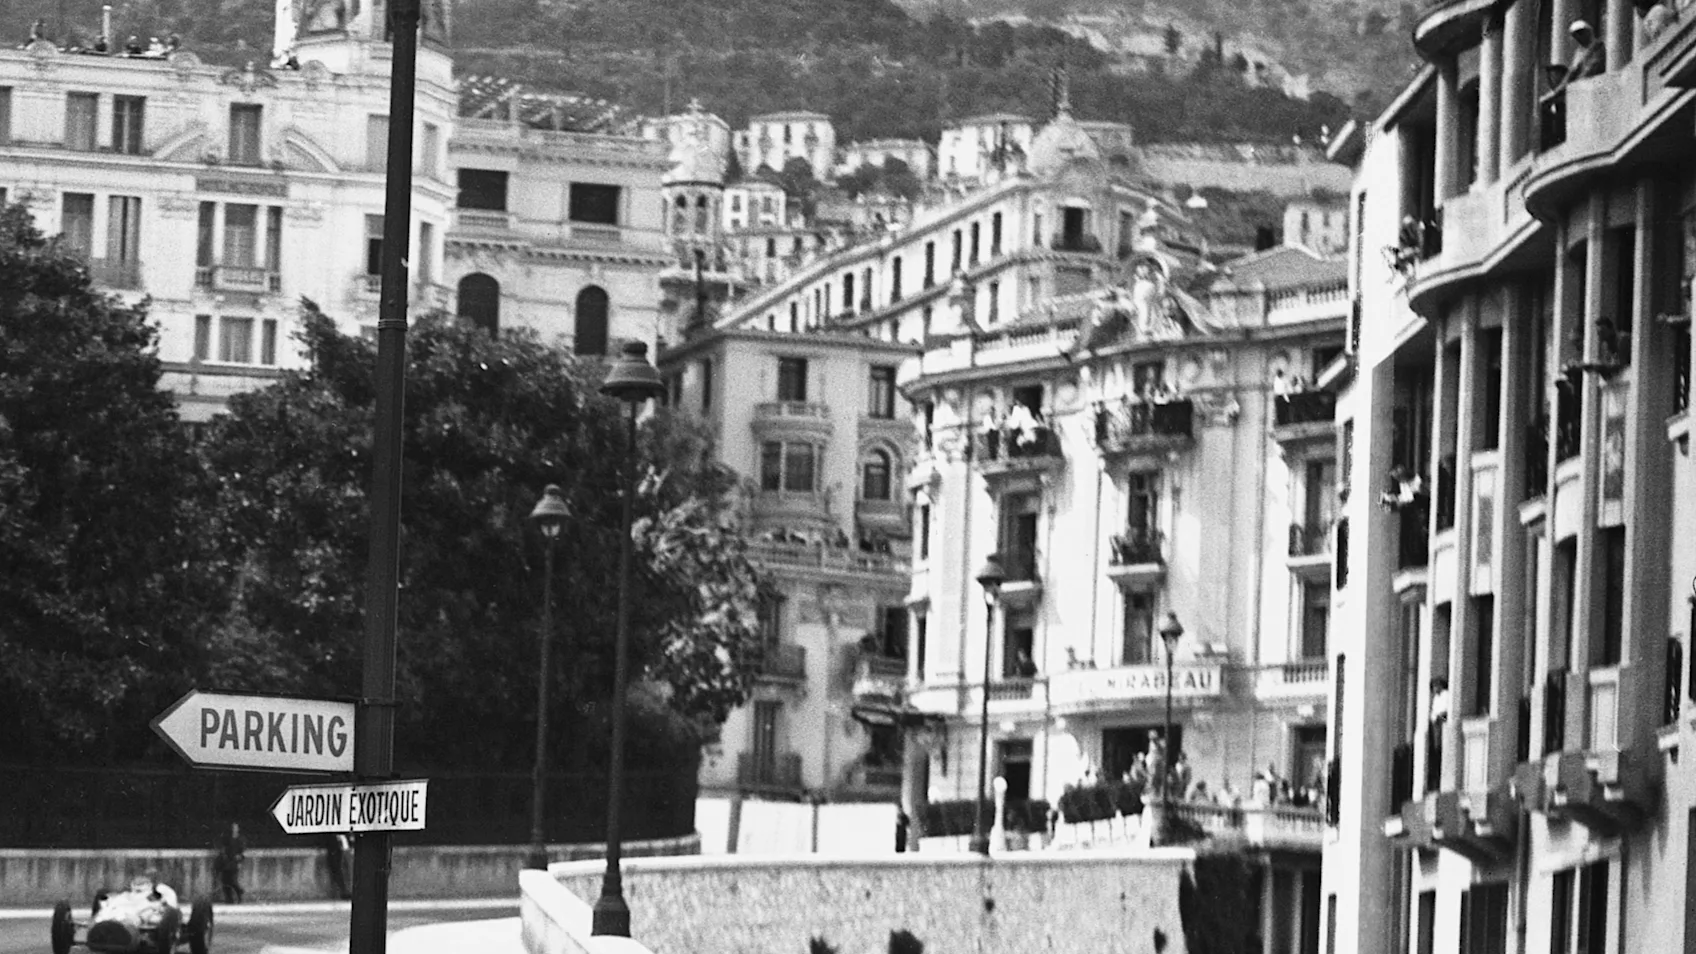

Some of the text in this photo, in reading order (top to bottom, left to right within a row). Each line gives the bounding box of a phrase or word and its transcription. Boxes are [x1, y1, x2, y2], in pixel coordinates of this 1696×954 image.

[200, 707, 348, 758] PARKING
[286, 789, 419, 828] JARDIN EXOTIQUE
